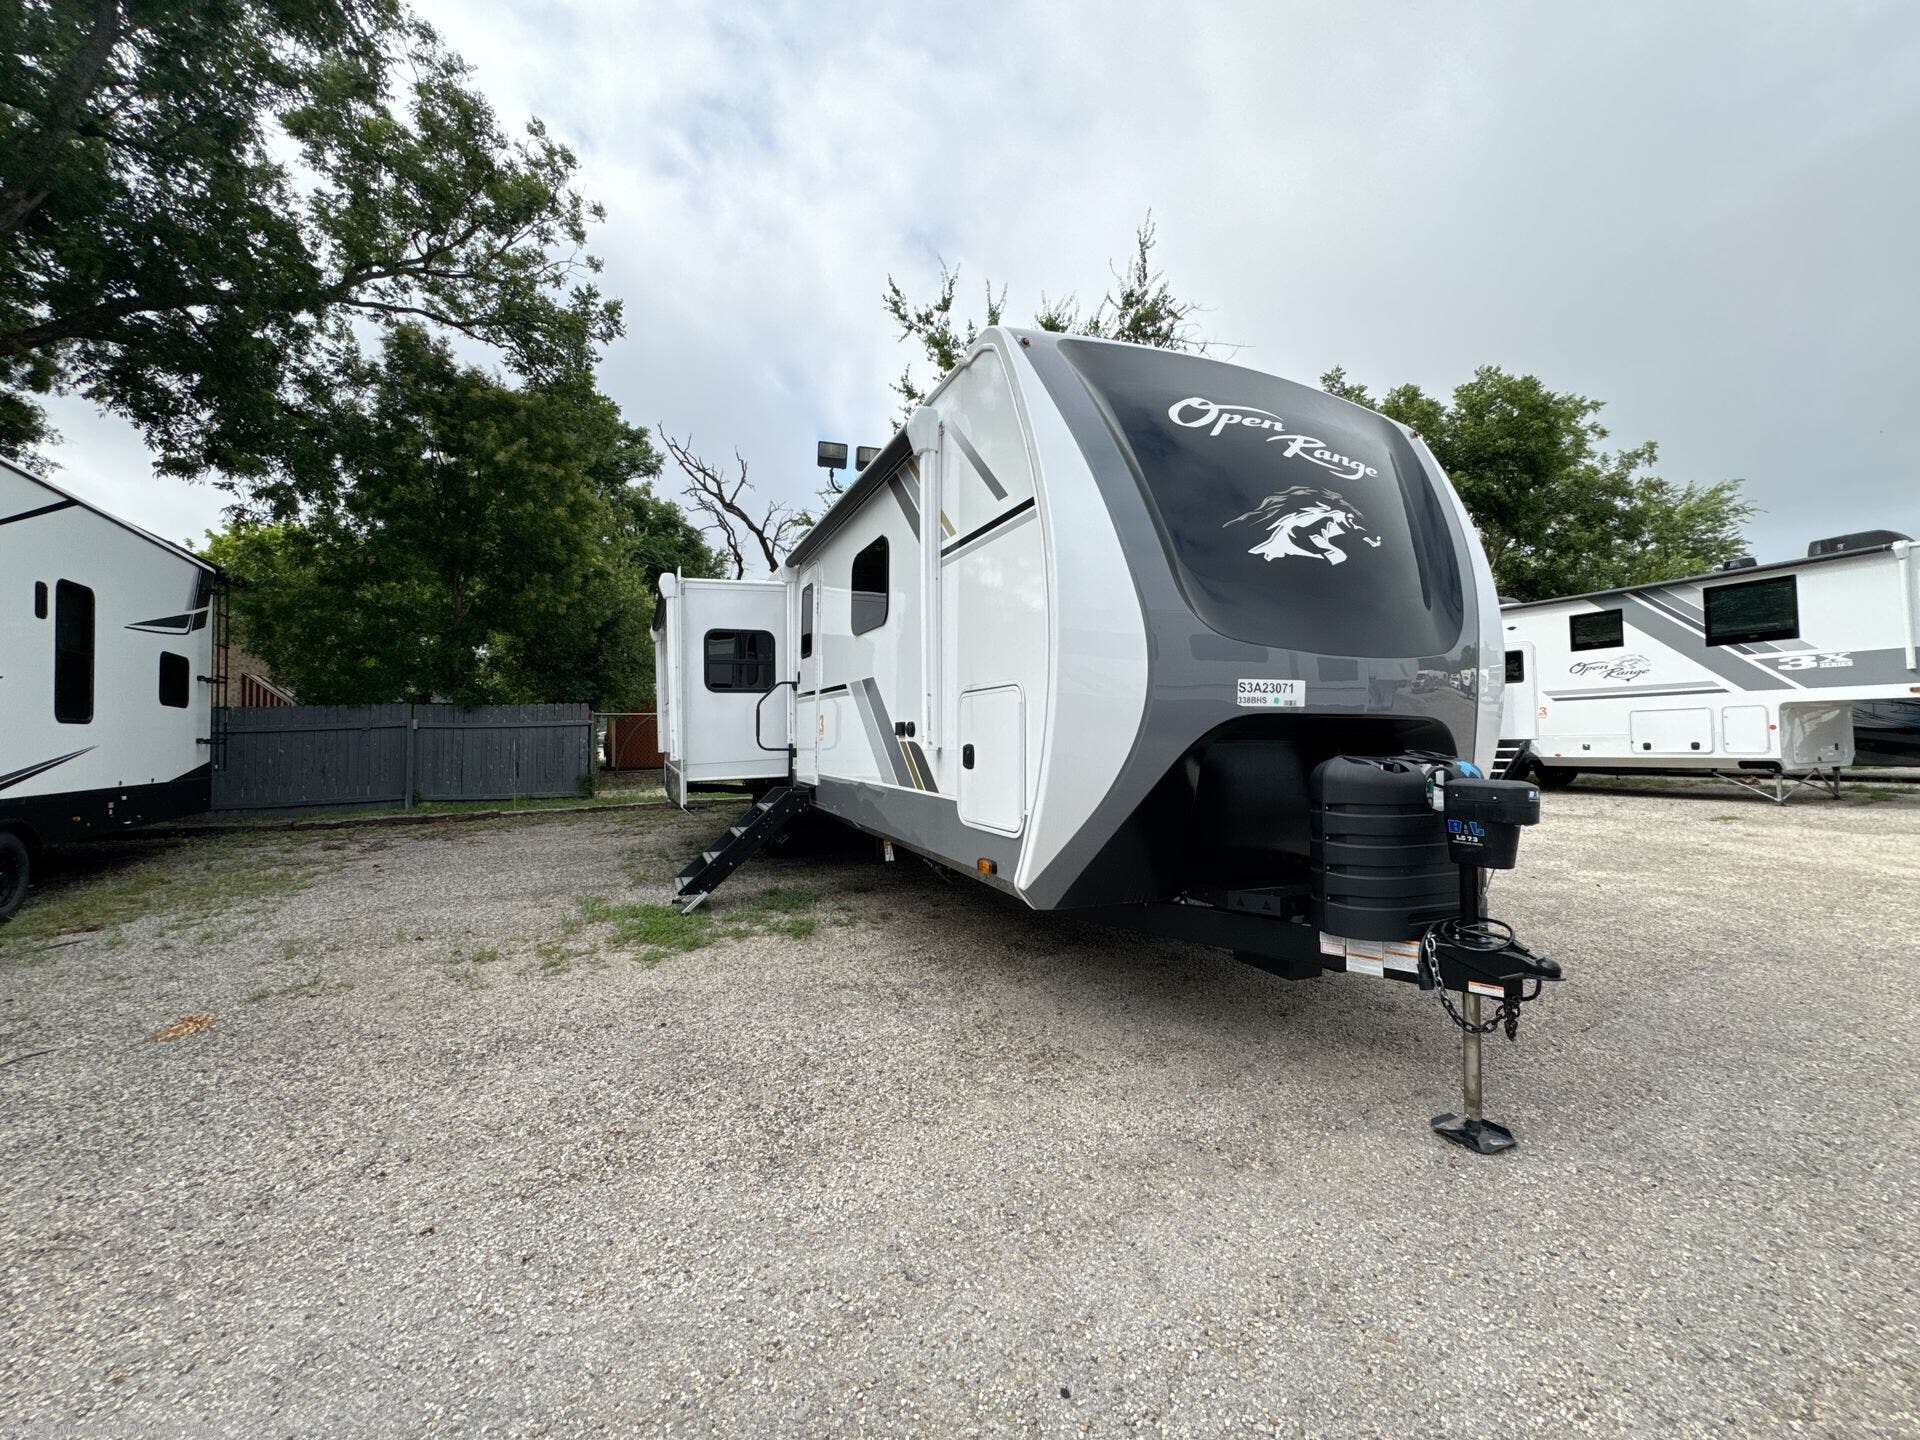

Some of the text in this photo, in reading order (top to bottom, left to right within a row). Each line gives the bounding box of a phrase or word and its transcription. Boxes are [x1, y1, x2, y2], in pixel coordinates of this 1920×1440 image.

[1167, 396, 1286, 436] Open
[1266, 434, 1379, 480] Range
[1569, 661, 1610, 676] Open
[1598, 667, 1651, 681] Range
[1238, 682, 1294, 694] S3A23071
[1238, 696, 1268, 704] 338BHS
